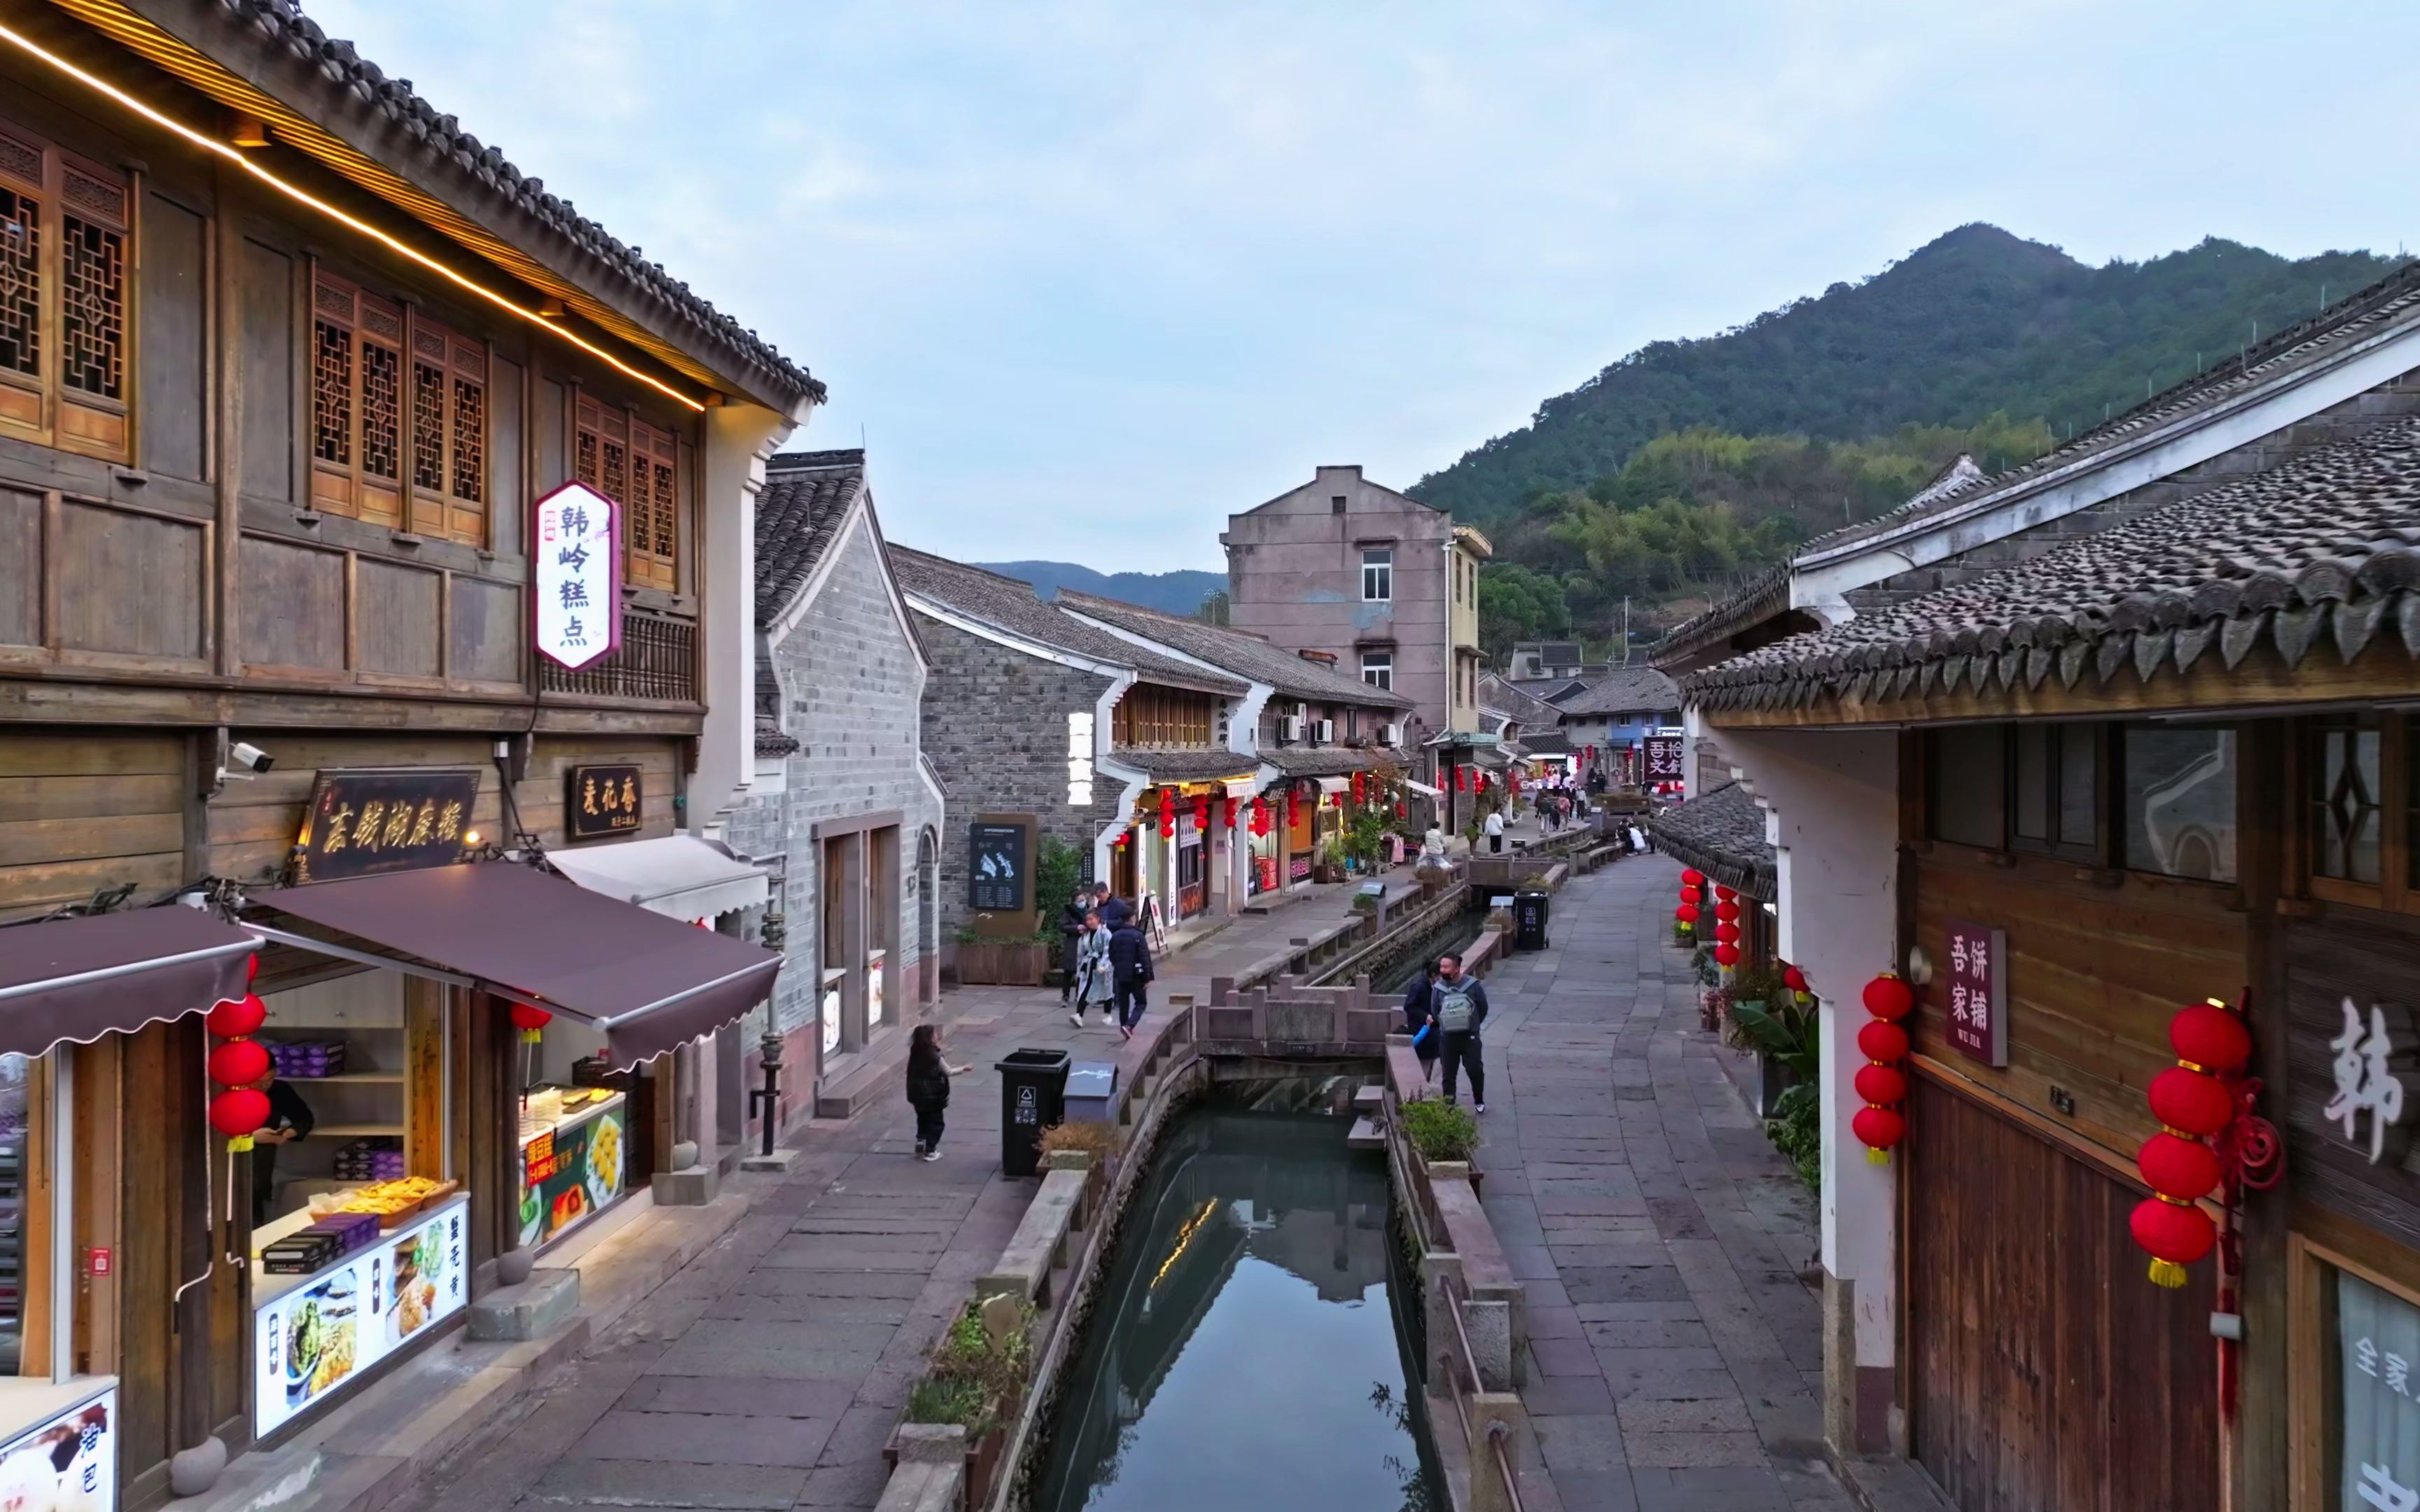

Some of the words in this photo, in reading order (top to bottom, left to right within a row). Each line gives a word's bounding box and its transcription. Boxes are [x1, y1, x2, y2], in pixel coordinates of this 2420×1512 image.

[559, 505, 590, 647] 韩岭糕点
[1951, 934, 1969, 1021] 吾家
[1970, 940, 1988, 1031] 饼铺
[1957, 1028, 1968, 1043] WU
[1969, 1032, 1981, 1049] JIA
[2323, 995, 2404, 1166] 韩
